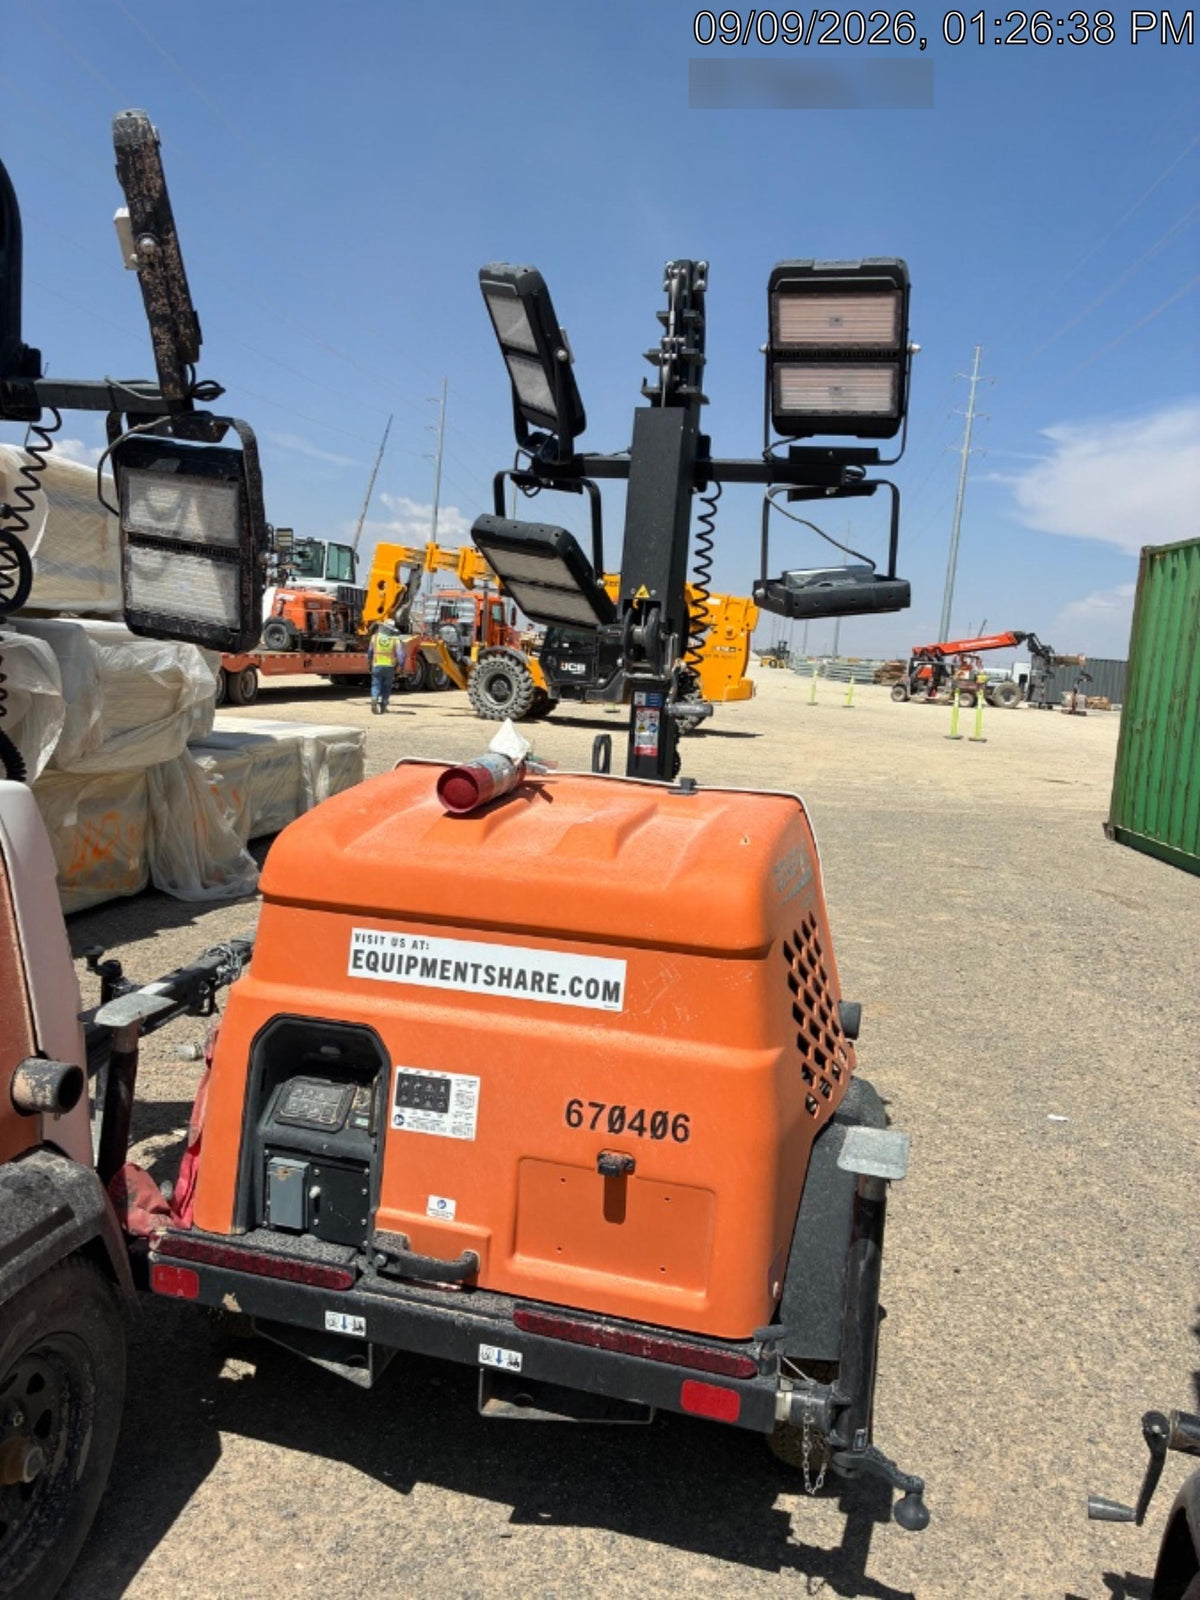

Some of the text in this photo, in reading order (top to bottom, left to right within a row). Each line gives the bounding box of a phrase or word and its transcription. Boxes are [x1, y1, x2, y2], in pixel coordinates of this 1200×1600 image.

[560, 659, 586, 672] JCB
[354, 932, 430, 950] VISIT US AT:
[351, 948, 622, 1004] EQUIPMENTSHARE.COM
[565, 1098, 691, 1143] 670406
